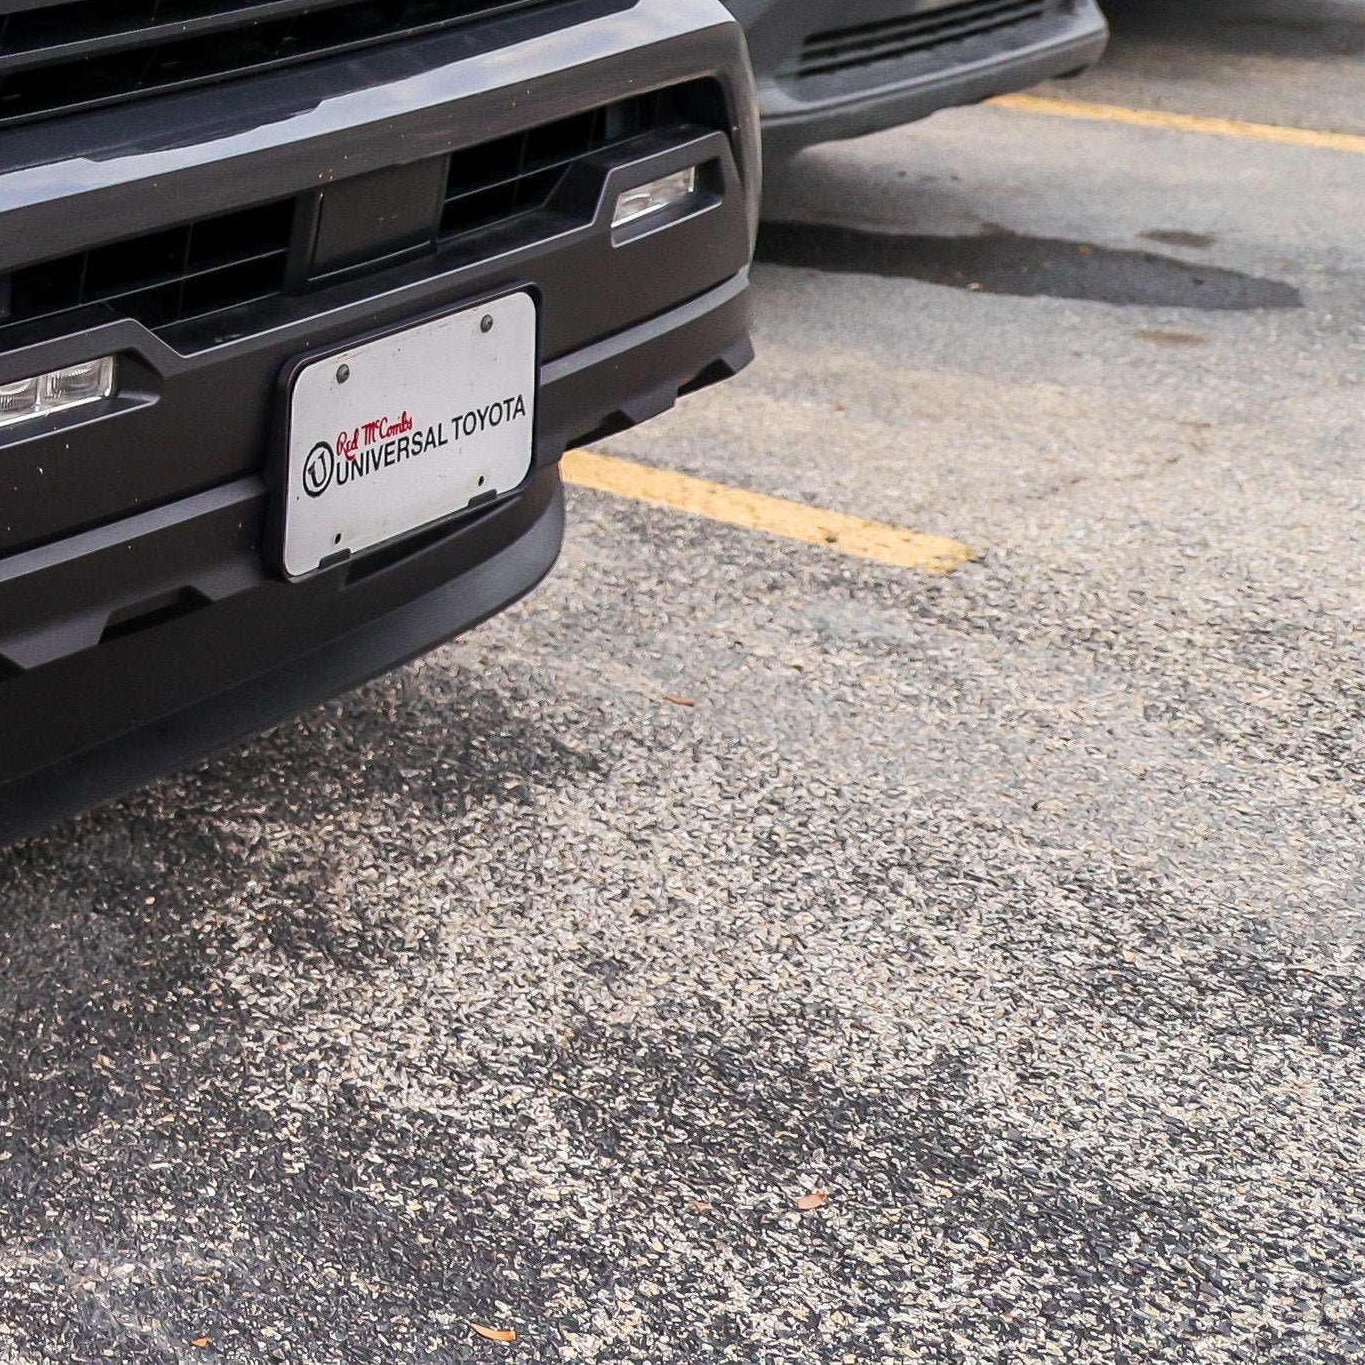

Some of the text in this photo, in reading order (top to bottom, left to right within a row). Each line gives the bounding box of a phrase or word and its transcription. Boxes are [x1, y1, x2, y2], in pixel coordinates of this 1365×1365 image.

[336, 411, 414, 461] Red McCombs
[336, 394, 526, 486] UNIVERSAL TOYOTA
